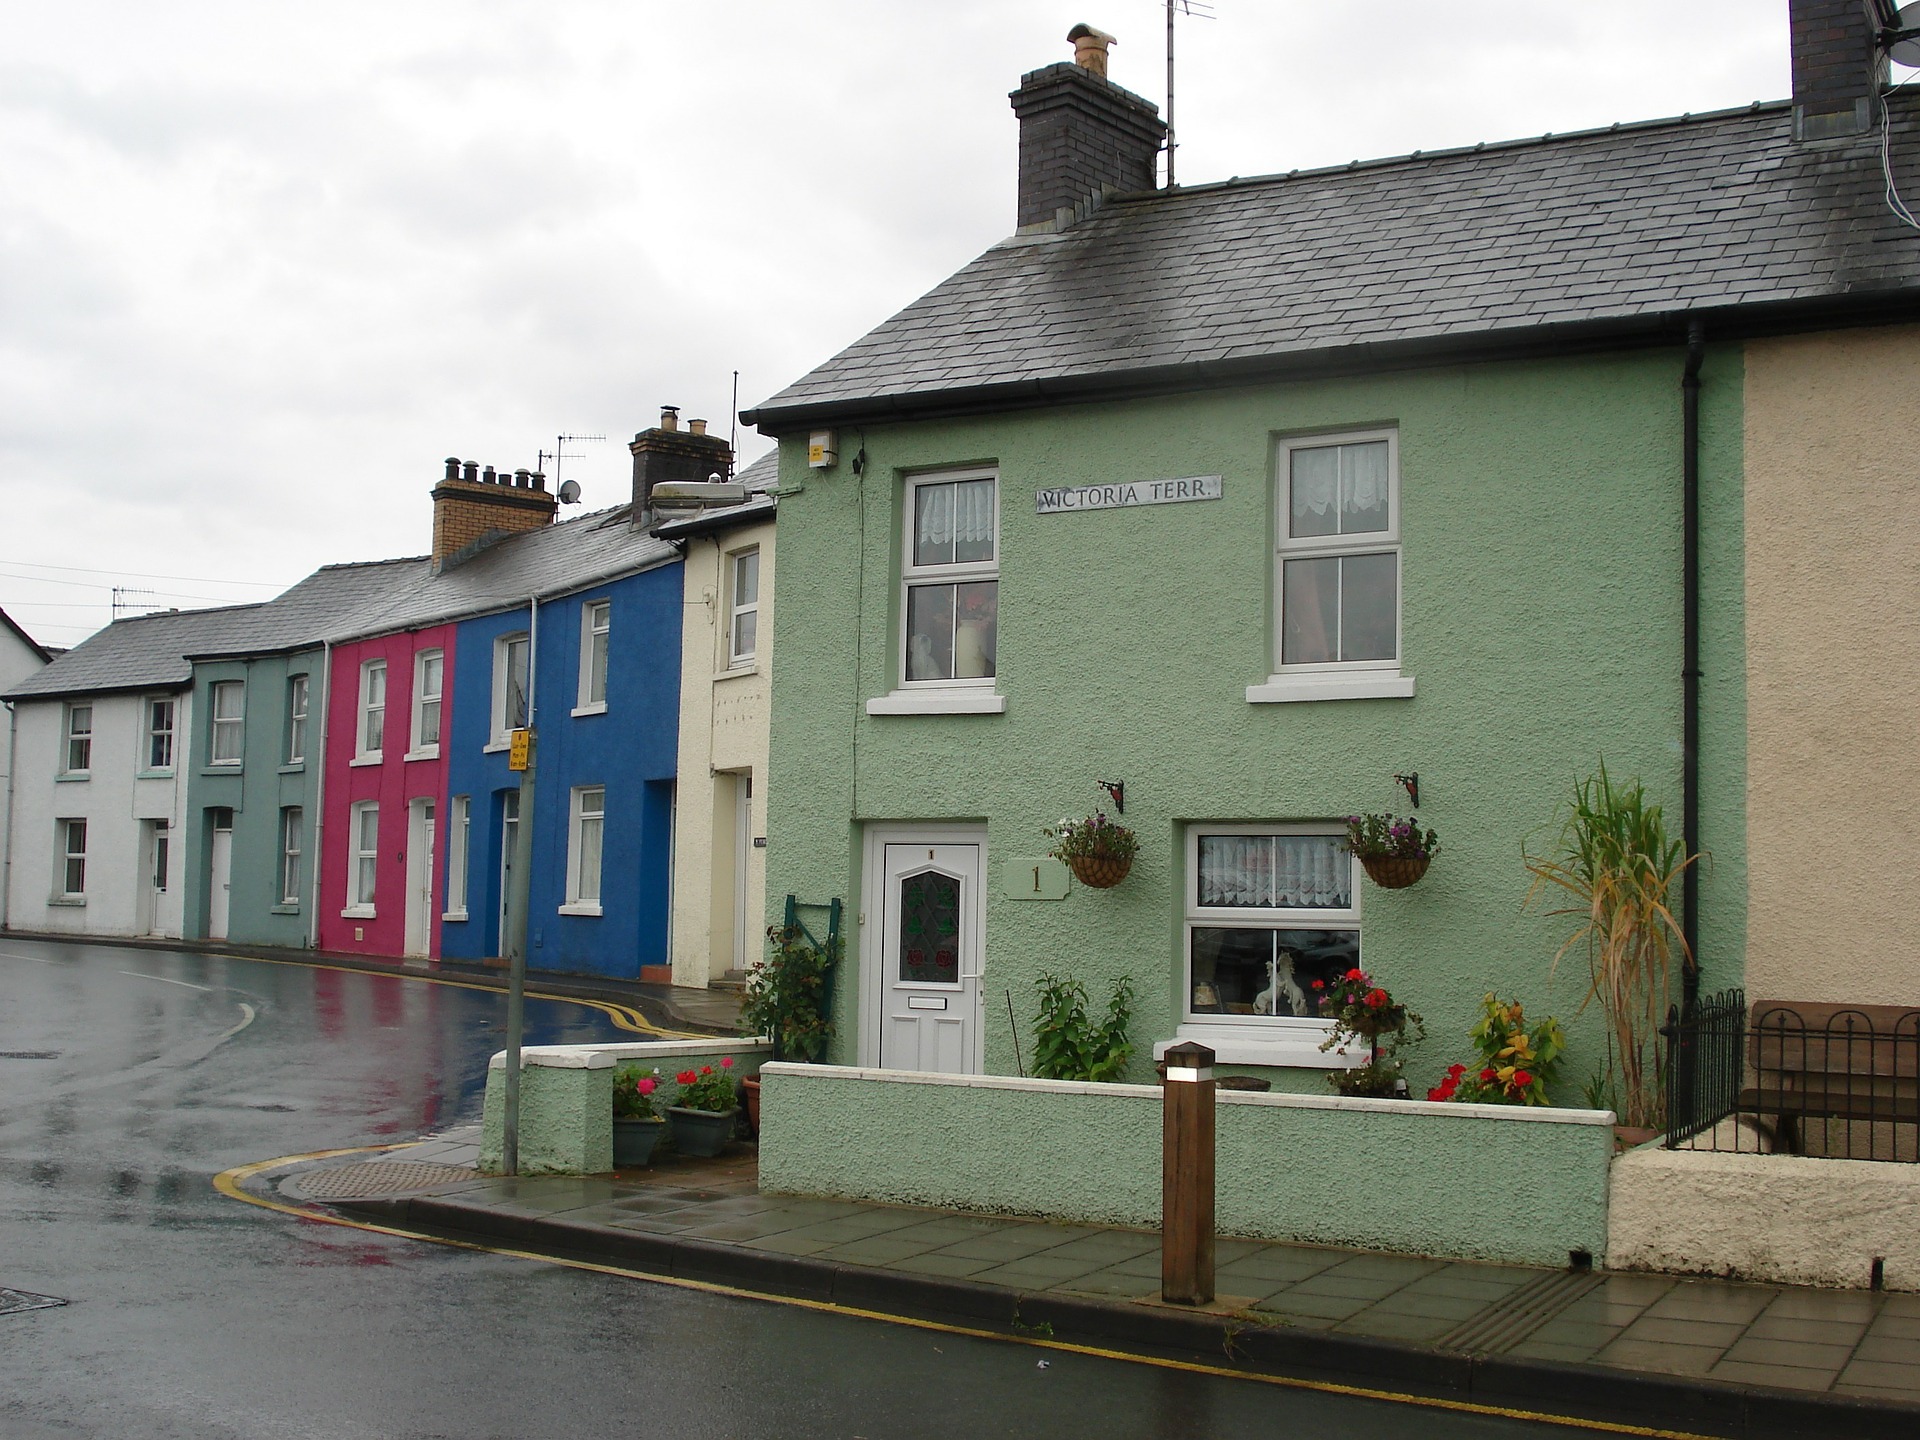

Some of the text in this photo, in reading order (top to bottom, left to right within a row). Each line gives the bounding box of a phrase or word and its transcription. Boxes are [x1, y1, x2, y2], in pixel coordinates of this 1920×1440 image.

[1043, 480, 1211, 508] VICTORIA TERR.
[1032, 865, 1042, 892] 1
